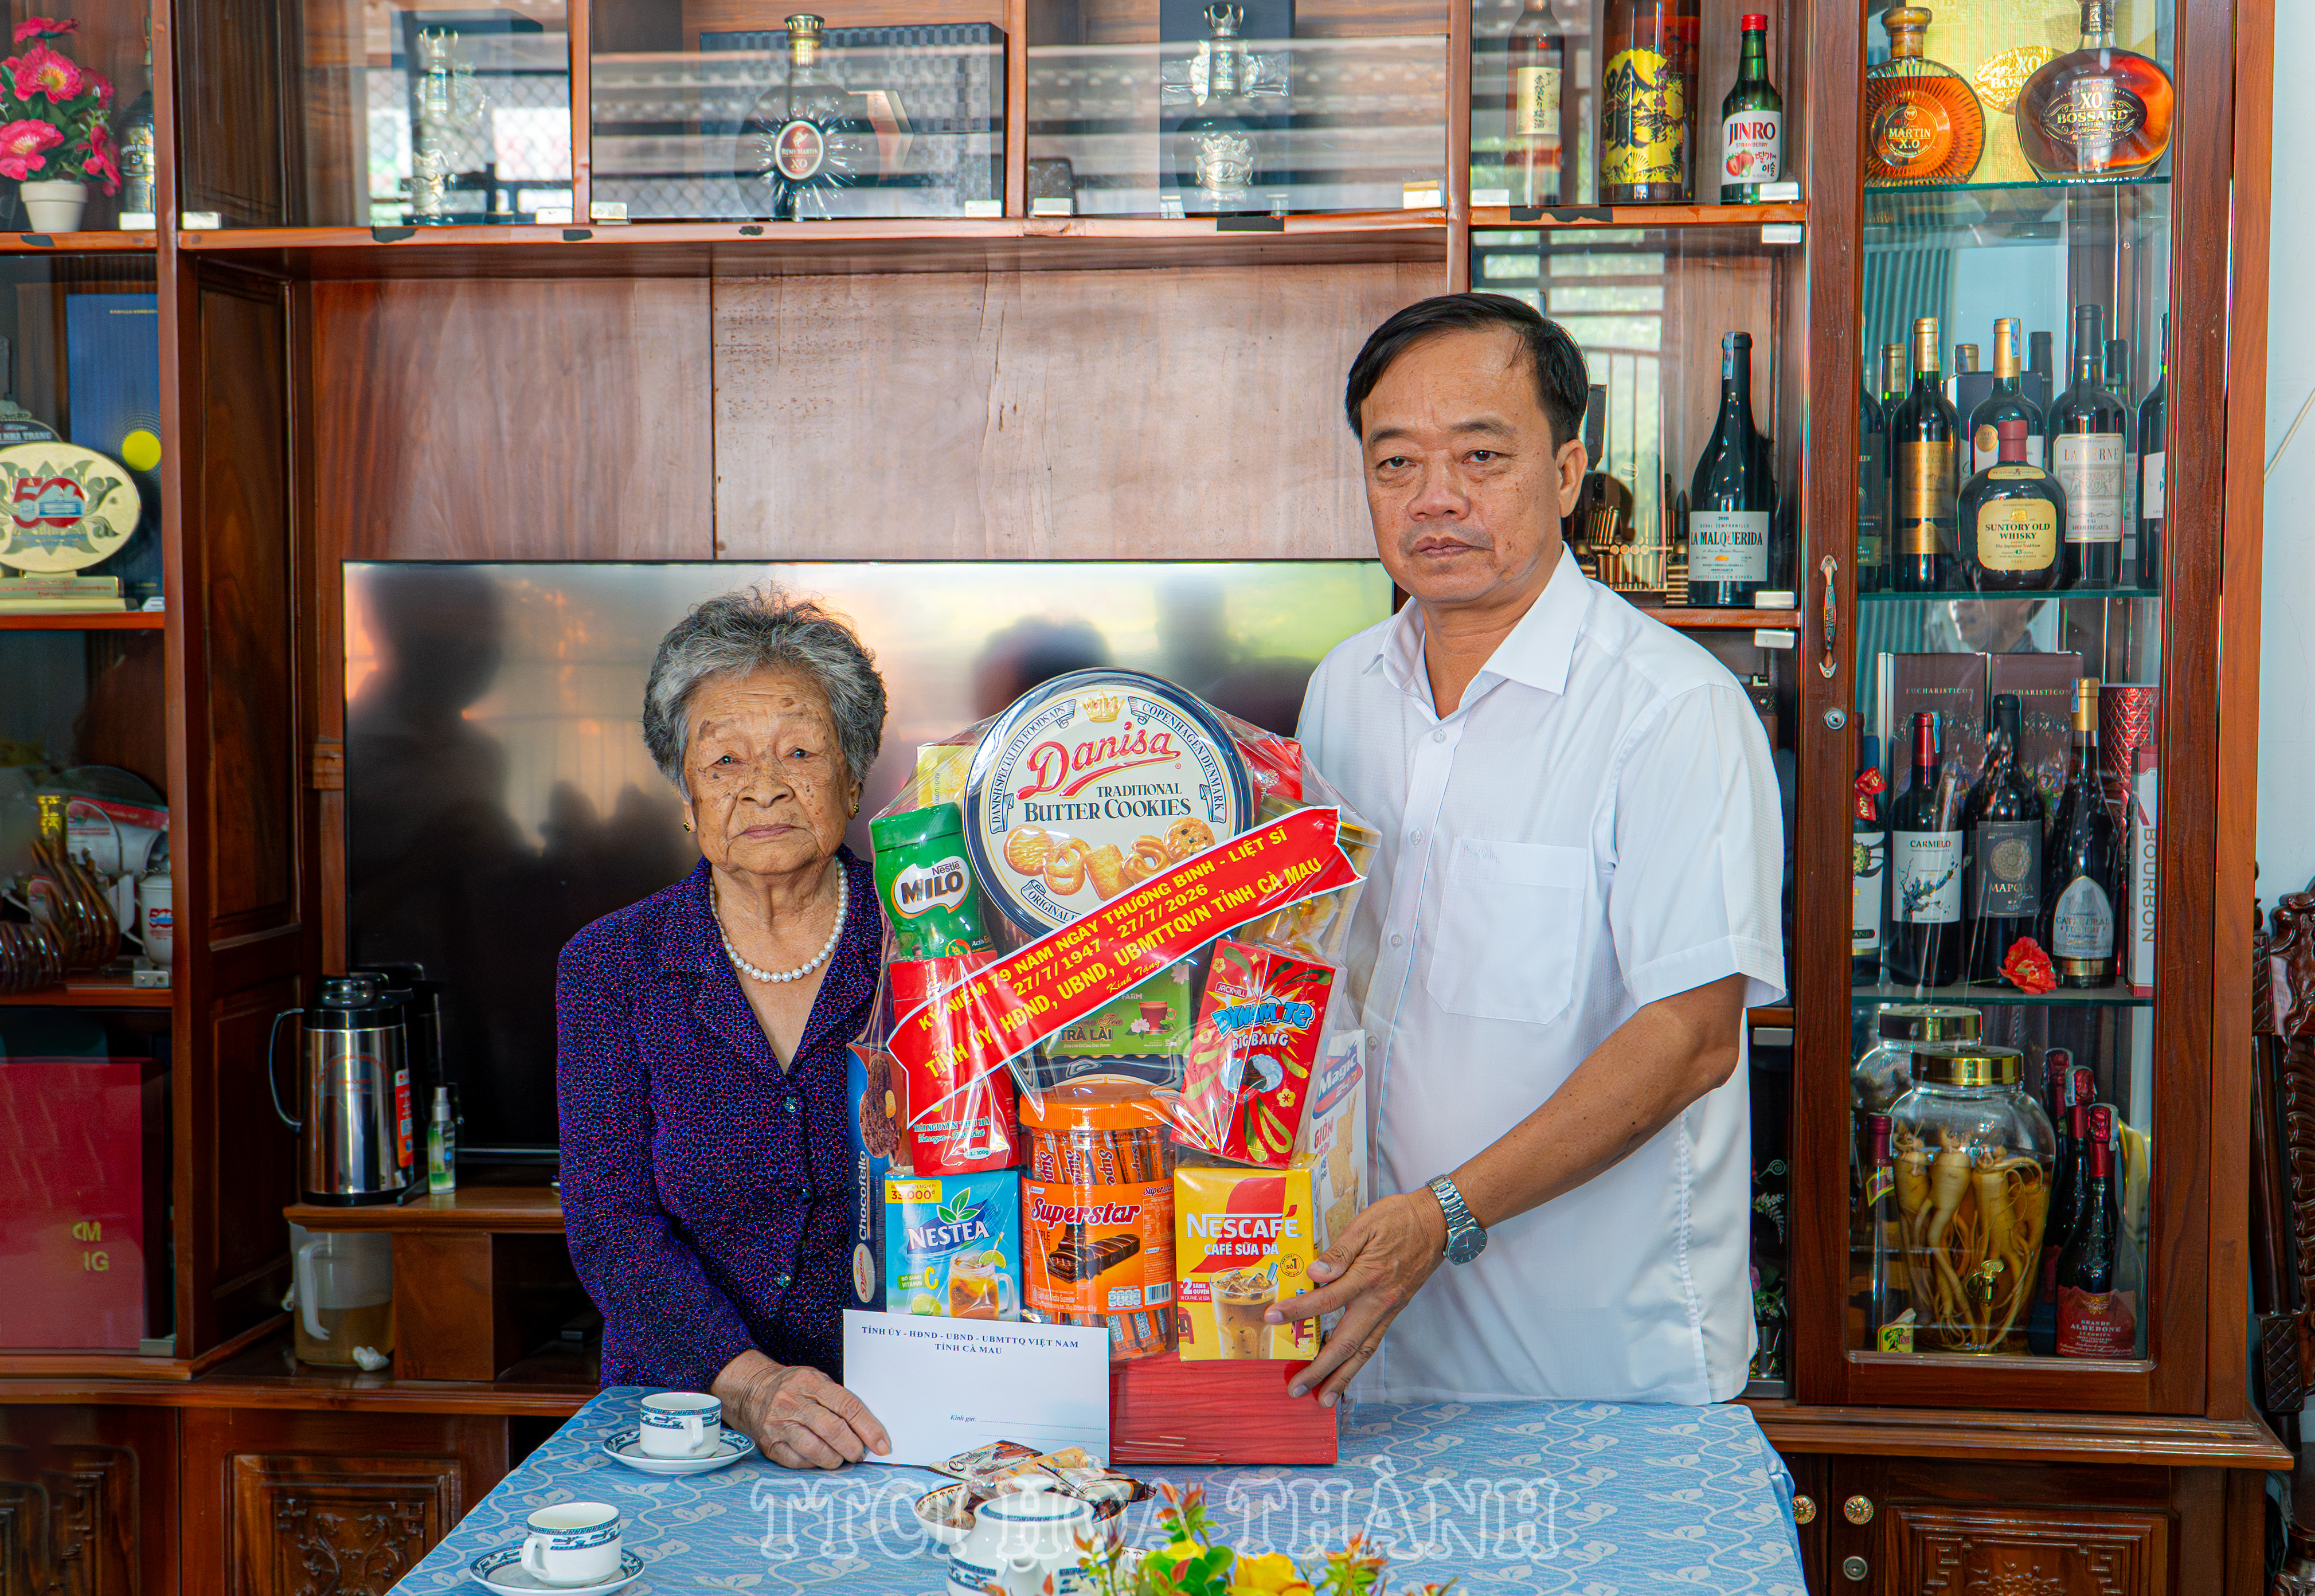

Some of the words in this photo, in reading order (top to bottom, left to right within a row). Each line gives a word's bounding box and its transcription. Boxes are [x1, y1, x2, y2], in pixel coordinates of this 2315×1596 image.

[2080, 91, 2103, 109] XO
[2056, 109, 2128, 124] BOSSARD
[1728, 122, 1776, 147] JINRO
[1888, 127, 1931, 138] MARTIN
[2064, 449, 2077, 461] LA
[2083, 448, 2119, 461] VERNE
[1691, 532, 1698, 545] LA
[1700, 531, 1763, 547] MALQUERIDA
[1985, 523, 2031, 531] SUNTORY
[2032, 523, 2051, 531] OLD
[1022, 714, 1051, 741] FOODS
[995, 737, 1026, 789] SPECIALITY
[1016, 721, 1182, 800] Danisa
[1142, 703, 1206, 757] COPENHAGEN
[1201, 756, 1225, 811] DENMARK
[1096, 783, 1183, 798] TRADITIONAL
[992, 788, 1003, 823] DANISH
[1024, 802, 1101, 822] BUTTER
[1104, 797, 1192, 819] COOKIES
[1910, 840, 1952, 848] CARMELO
[901, 871, 965, 905] MILO
[2142, 828, 2156, 942] BOURBON
[1028, 890, 1069, 922] ORIGINAL
[918, 1005, 940, 1031] KỶ
[944, 981, 988, 1015] NIỆM
[988, 969, 1011, 989] 79
[1014, 945, 1054, 975] NĂM
[1055, 921, 1100, 952] NGÀY
[1101, 883, 1172, 925] THƯƠNG
[1172, 861, 1215, 889] BINH
[1228, 836, 1265, 863] LIỆT
[1270, 825, 1288, 845] SĨ
[1012, 938, 1101, 997] 27/7/1947
[1117, 883, 1209, 937] 27/7/2026
[924, 1042, 969, 1078] TỈNH
[968, 1026, 1001, 1051] ỦY,
[999, 994, 1058, 1033] HĐND,
[1057, 962, 1115, 1000] UBND,
[1113, 905, 1213, 967] UBMTTQVN
[1210, 885, 1256, 914] TỈNH
[1257, 870, 1284, 893] CÀ
[1282, 857, 1323, 885] MAU
[1106, 973, 1132, 993] Kính
[1133, 960, 1162, 976] Tặng
[1061, 1026, 1088, 1042] TRÀ
[1089, 1026, 1114, 1042] LÀI
[1232, 1034, 1249, 1051] BIG
[1251, 1032, 1289, 1047] BANG
[1319, 1053, 1358, 1098] Magic
[926, 1119, 958, 1132] NGUYÊN
[978, 1116, 991, 1126] HÀ
[858, 1150, 867, 1241] Chocofello
[1143, 1183, 1175, 1197] Superstar
[1031, 1197, 1142, 1230] Superstar
[1186, 1204, 1300, 1238] NESCAFÉ
[906, 1221, 992, 1250] NESTEA
[1204, 1241, 1233, 1255] CAFÉ
[1235, 1241, 1260, 1255] SỮA
[1262, 1241, 1280, 1255] ĐÁ
[924, 1266, 939, 1290] C
[862, 1325, 885, 1336] TỈNH
[888, 1326, 902, 1336] ỦY
[909, 1330, 938, 1339] HĐND
[946, 1333, 974, 1341] UBND
[982, 1335, 1026, 1346] UBMTTQ
[1028, 1338, 1053, 1348] VIỆT
[1055, 1340, 1079, 1348] NAM
[2070, 1323, 2121, 1332] ALBERONE
[935, 1342, 960, 1352] TỈNH
[963, 1344, 977, 1353] CÀ
[979, 1346, 1003, 1355] MAU
